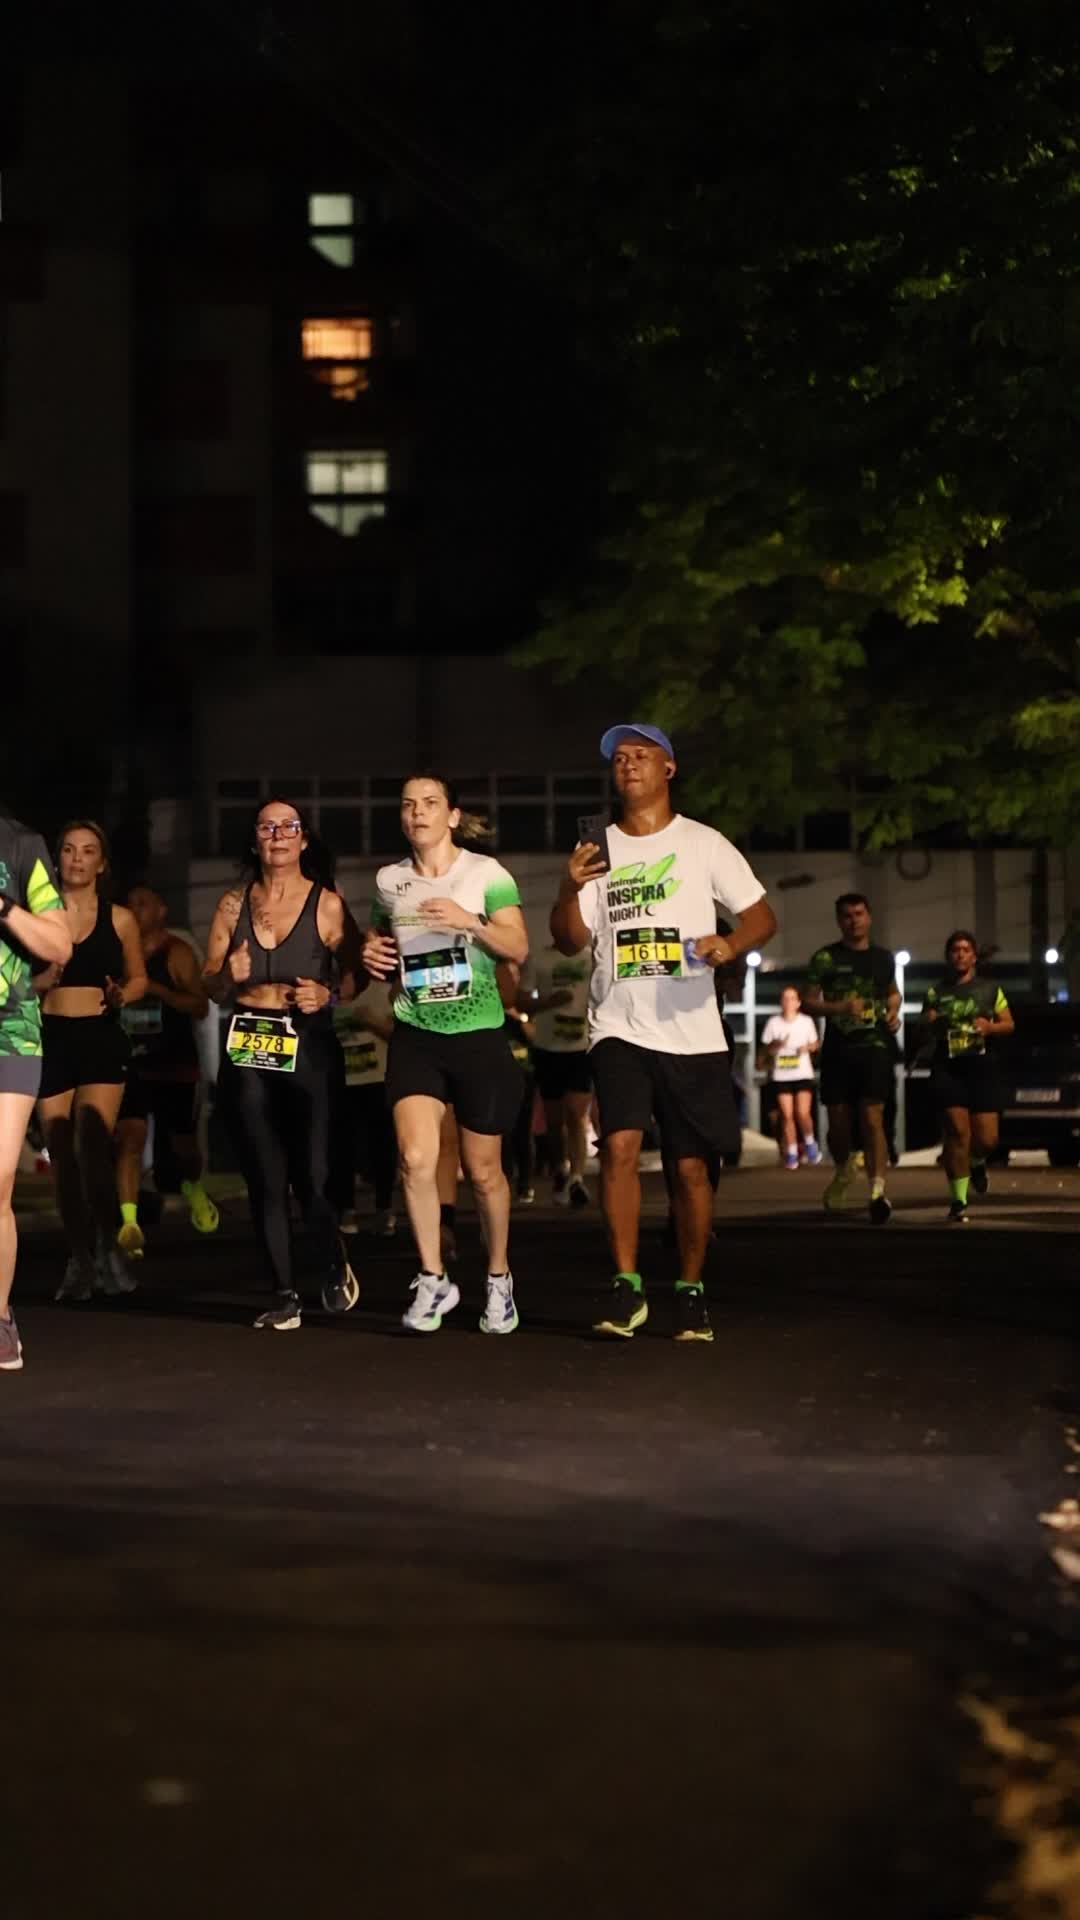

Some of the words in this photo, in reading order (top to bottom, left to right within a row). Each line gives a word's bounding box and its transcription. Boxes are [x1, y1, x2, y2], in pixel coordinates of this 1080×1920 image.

[608, 884, 665, 907] INSPIRA
[609, 906, 641, 923] NIGHT
[630, 945, 667, 961] 1611
[241, 1033, 285, 1052] 2578
